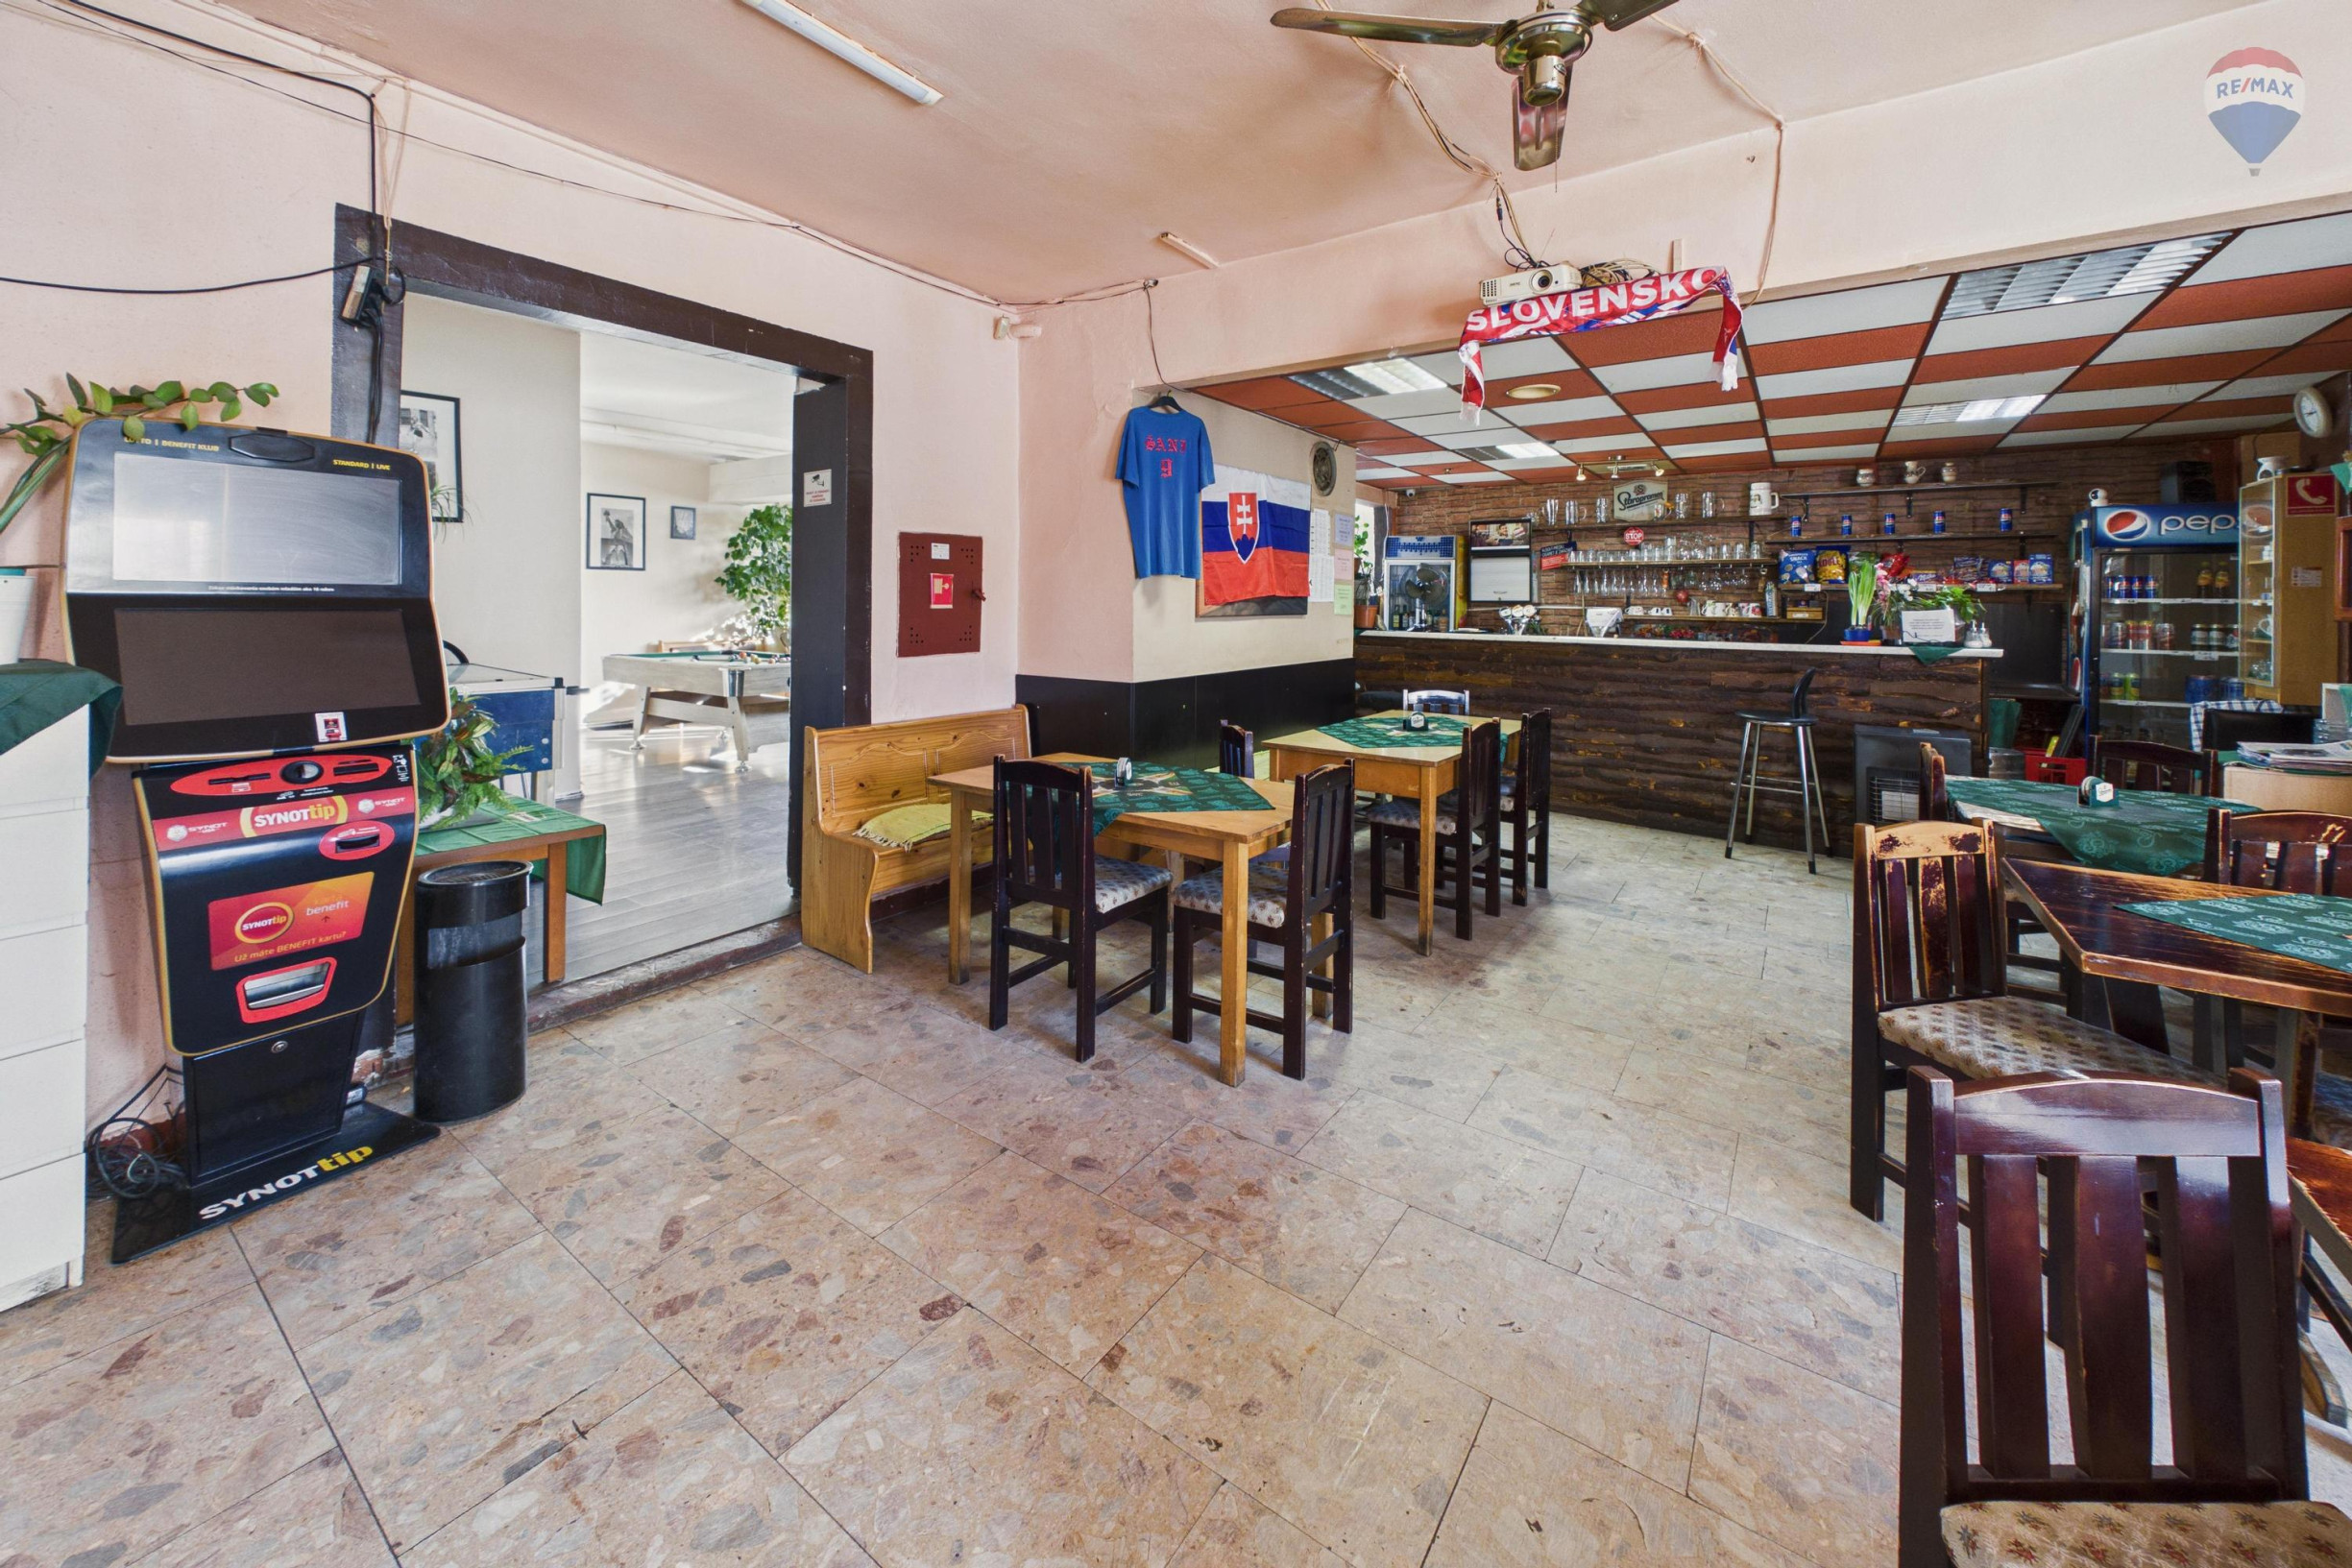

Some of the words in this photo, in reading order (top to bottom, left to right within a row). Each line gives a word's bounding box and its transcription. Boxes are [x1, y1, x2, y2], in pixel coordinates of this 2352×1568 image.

[1466, 266, 1726, 332] SLOVENSKO
[161, 440, 196, 449] BENEFIT
[198, 444, 219, 452] KLUB
[332, 459, 370, 469] STANDARD
[1617, 491, 1665, 511] Staropramen
[2161, 514, 2241, 536] pep
[254, 804, 336, 829] SYNOTtip
[306, 900, 350, 916] benefit
[234, 952, 249, 963] Už
[250, 947, 275, 959] máte
[277, 938, 317, 953] BENEFIT
[319, 930, 347, 944] kartu?
[199, 1146, 374, 1219] SYNOTtip
